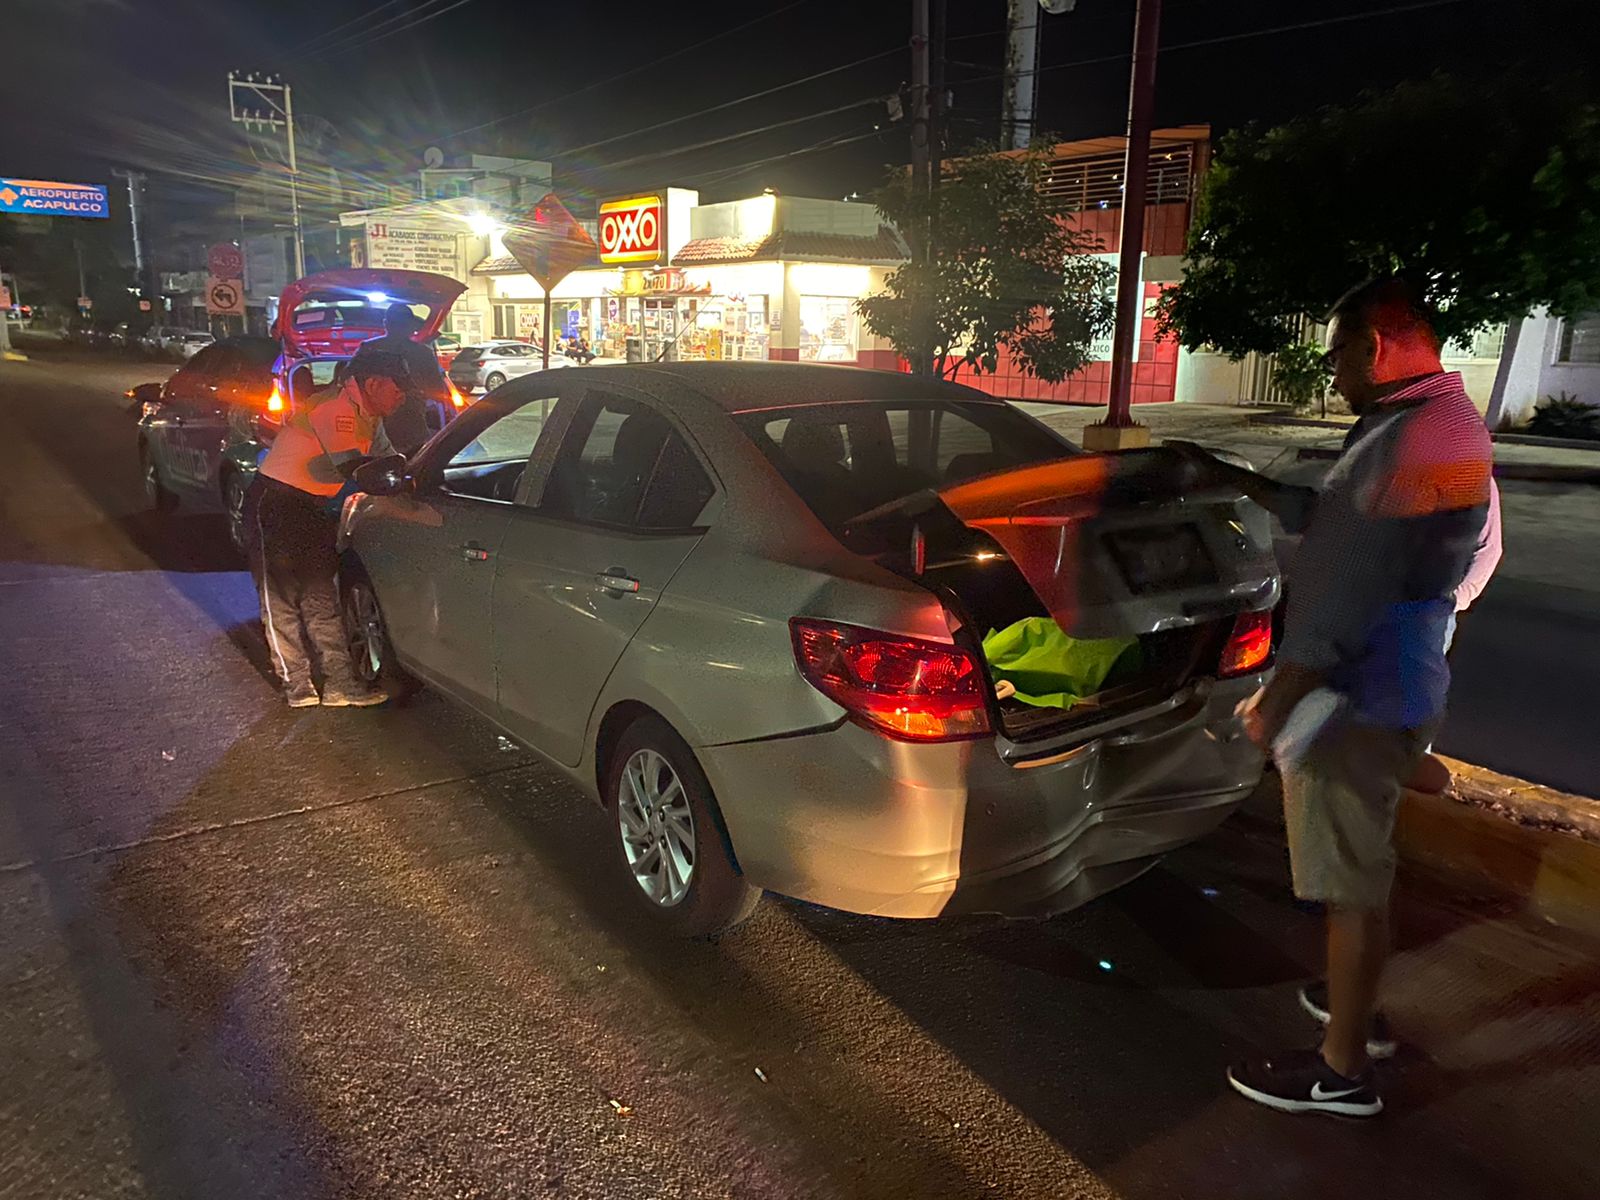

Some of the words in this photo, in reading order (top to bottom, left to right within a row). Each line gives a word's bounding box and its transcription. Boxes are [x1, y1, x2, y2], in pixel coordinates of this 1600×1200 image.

[20, 188, 104, 201] AEROPUERTO
[23, 199, 101, 212] ACAPULCO
[602, 208, 656, 252] OXXO
[1089, 343, 1110, 353] EXICO
